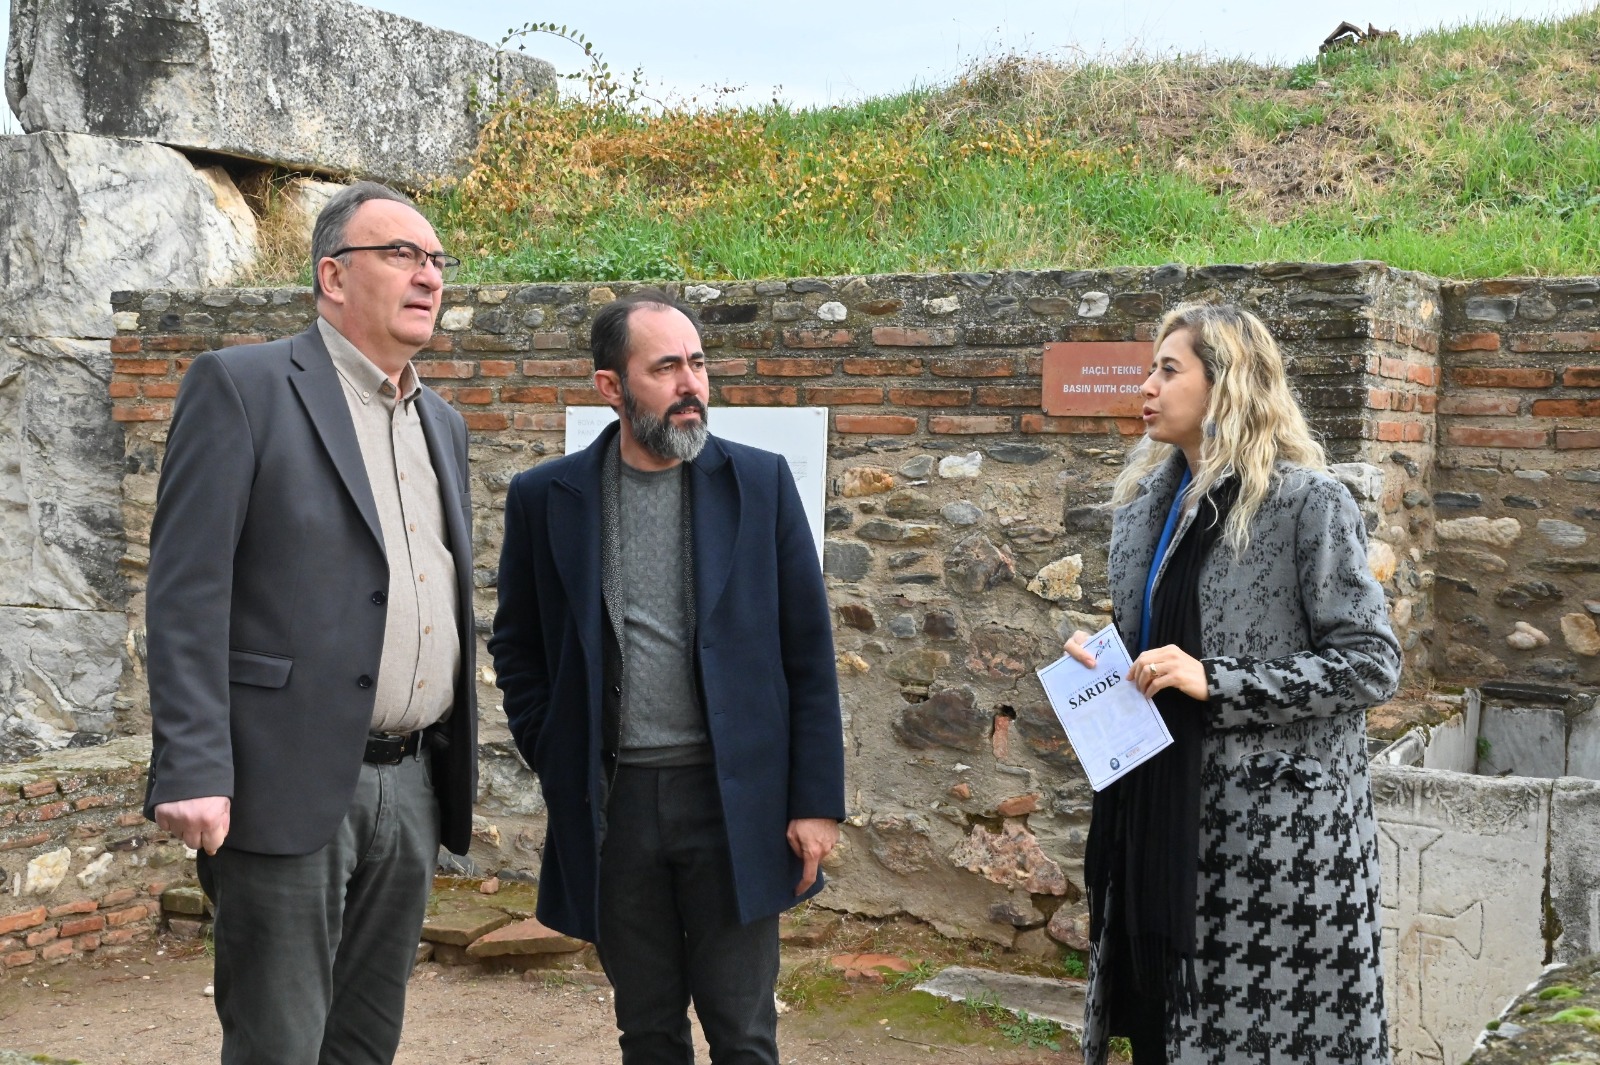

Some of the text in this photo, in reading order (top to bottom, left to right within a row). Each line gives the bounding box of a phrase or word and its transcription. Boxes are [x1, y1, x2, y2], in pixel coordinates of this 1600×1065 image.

[1082, 366, 1142, 376] HAÇLI TEKNE
[1063, 384, 1091, 393] BASIN
[1093, 384, 1117, 393] WITH
[1068, 670, 1121, 710] SARDES
